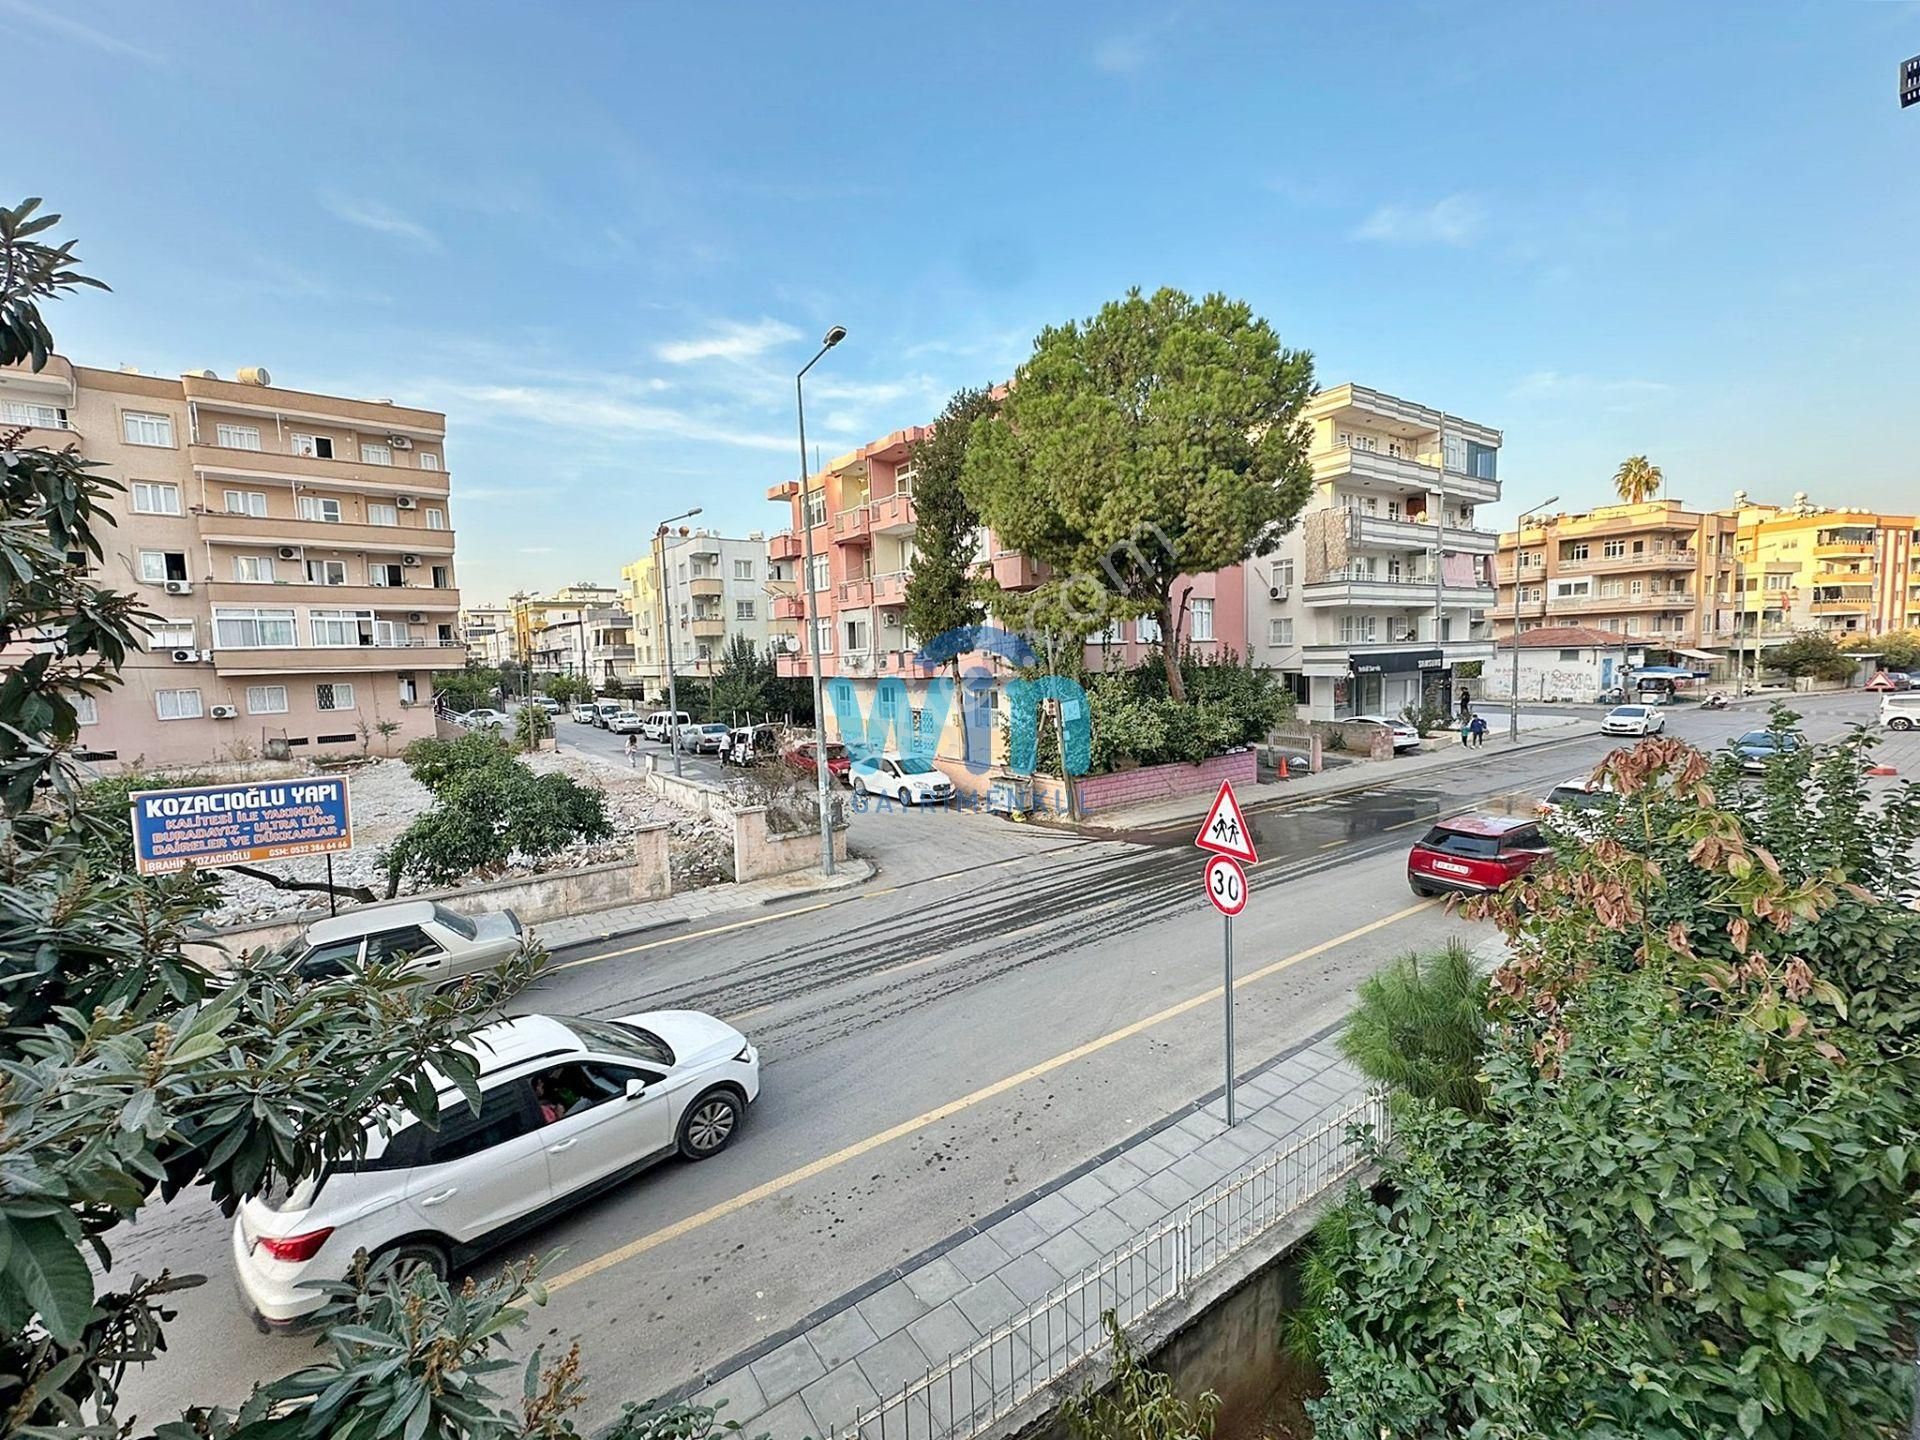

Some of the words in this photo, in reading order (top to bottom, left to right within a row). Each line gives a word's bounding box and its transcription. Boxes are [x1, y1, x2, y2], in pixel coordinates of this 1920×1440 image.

[145, 787, 285, 818] KOZACIOĞLU
[291, 784, 338, 804] YAPI
[152, 824, 240, 843] BURADAYIZ
[253, 818, 299, 832] ULTRA
[301, 814, 336, 827] LÜKS
[165, 812, 233, 830] KALİTESİ
[236, 810, 259, 822] İLE
[262, 805, 324, 820] YAKINDA
[152, 837, 228, 855] DAİRELER
[230, 835, 251, 847] VE
[253, 826, 338, 844] DÜKKANLAR
[290, 844, 309, 854] 0532
[191, 850, 251, 867] KOZACIOĞLU
[1213, 869, 1239, 901] 30
